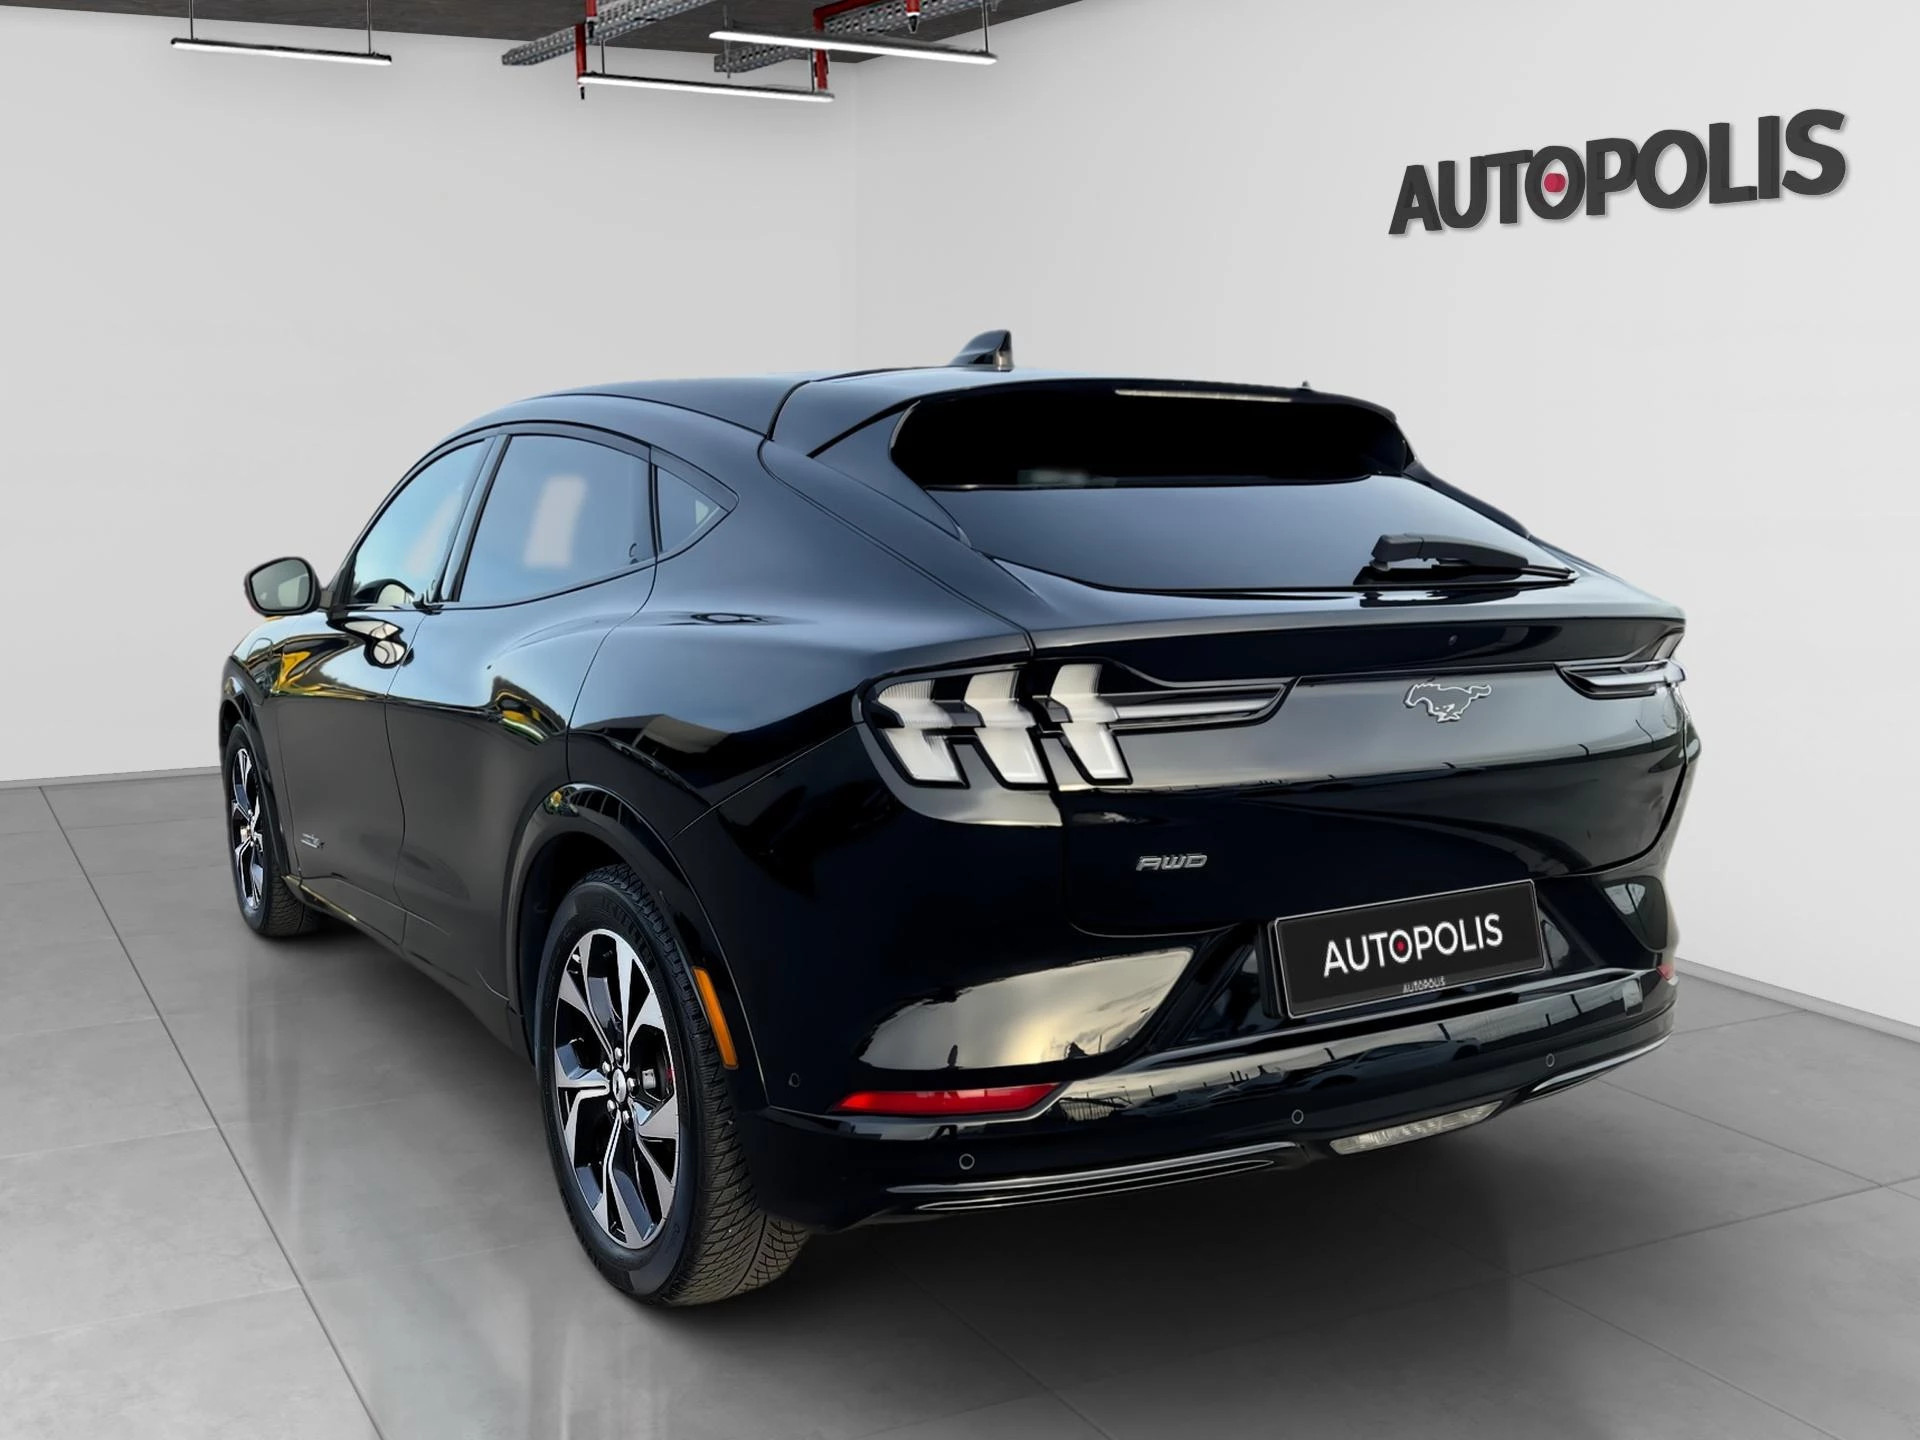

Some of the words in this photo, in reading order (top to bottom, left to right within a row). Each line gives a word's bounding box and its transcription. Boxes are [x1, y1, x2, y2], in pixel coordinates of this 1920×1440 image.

[1389, 108, 1846, 234] AUTOPOLIS
[1136, 854, 1207, 871] AWD
[1323, 913, 1503, 977] AUTOPOLIS
[1403, 976, 1446, 993] AUTOPOLIS
